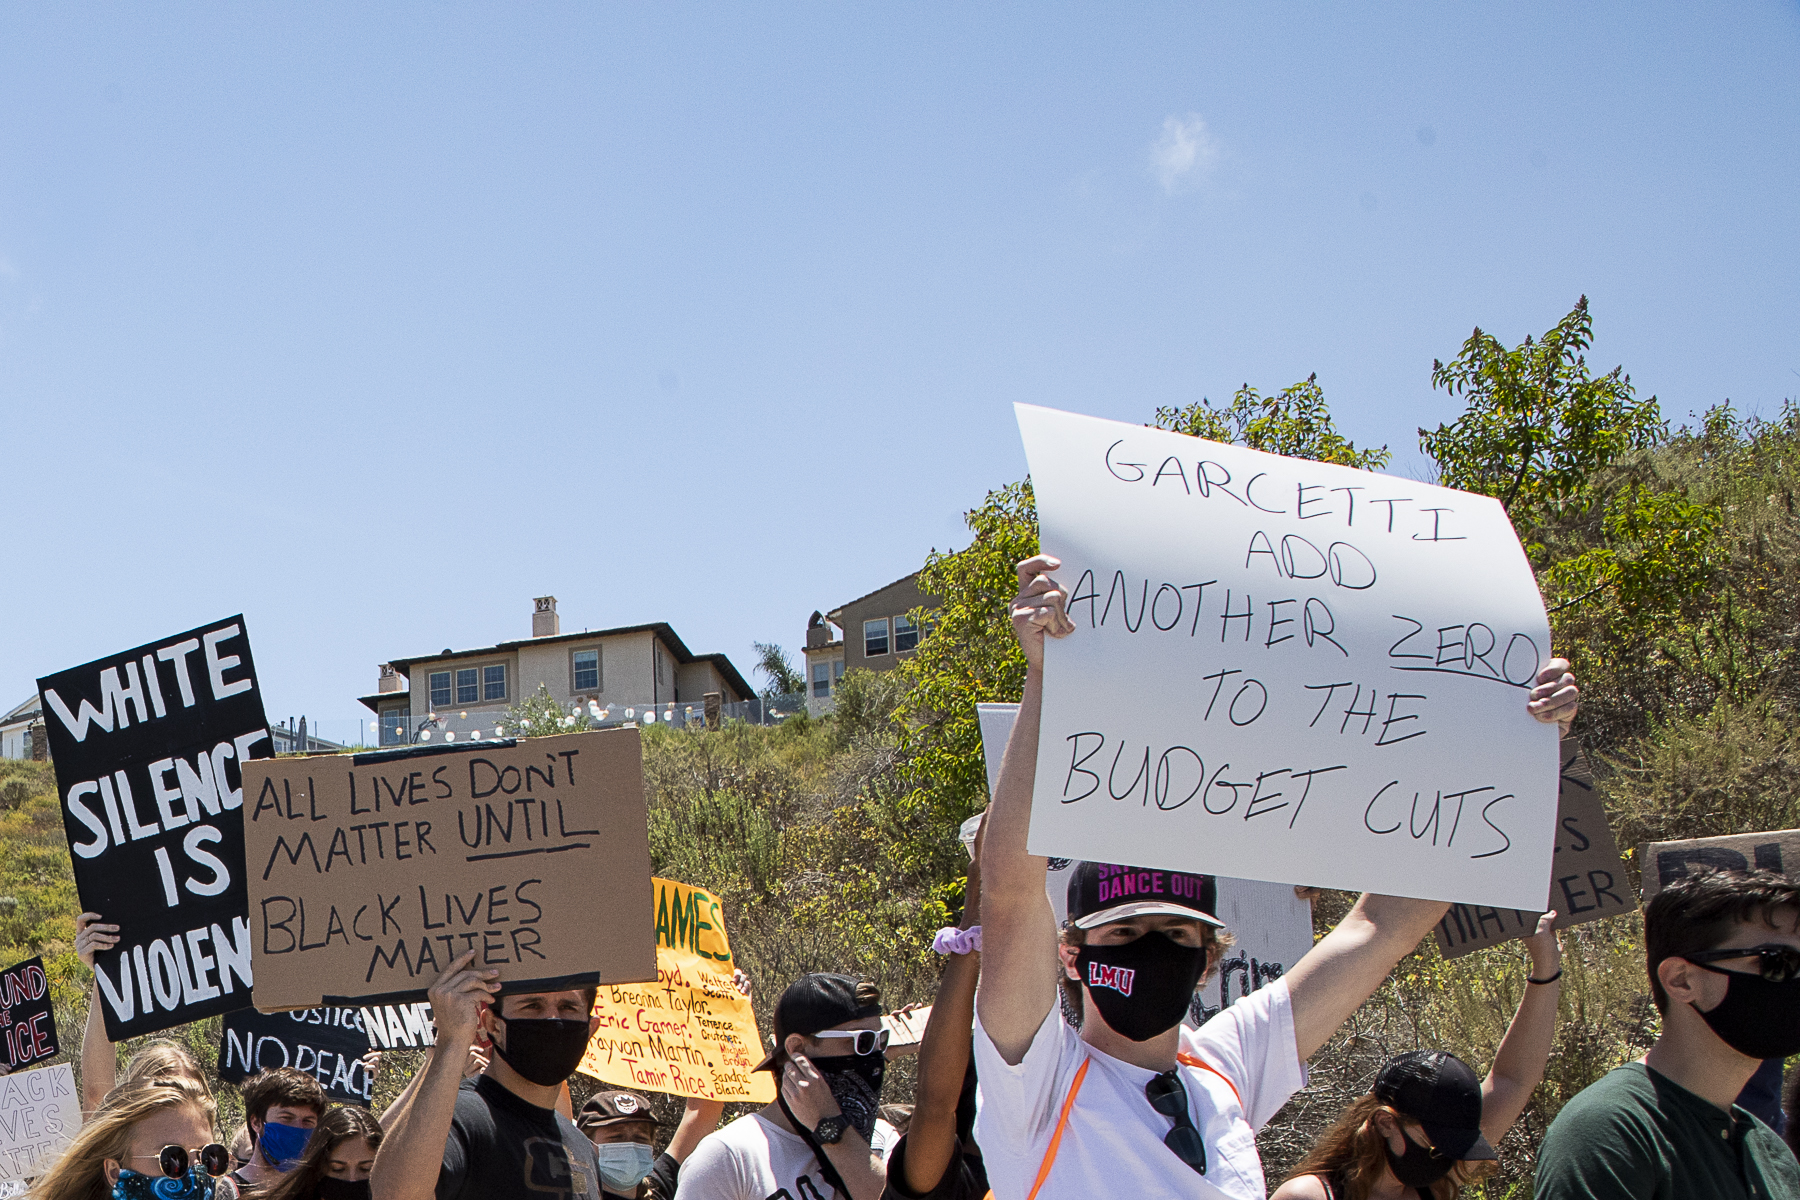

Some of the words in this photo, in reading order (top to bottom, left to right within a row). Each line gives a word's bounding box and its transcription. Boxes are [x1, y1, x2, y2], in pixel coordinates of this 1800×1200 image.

[1105, 440, 1467, 542] GARCETTI
[1246, 531, 1376, 590] ADD
[1066, 569, 1349, 657] ANOTHER
[1388, 614, 1540, 687] ZERO
[44, 623, 253, 743] WHITE
[1202, 669, 1268, 726] TO
[1304, 682, 1427, 746] THE
[252, 776, 328, 822] ALL
[350, 766, 452, 816] LIVES
[1061, 732, 1348, 829] BUDGET
[1364, 780, 1515, 859] CUTS
[153, 824, 231, 908] IS
[262, 820, 437, 881] MATTER
[457, 799, 601, 849] UNTIL
[260, 893, 402, 956] BLACK
[420, 879, 544, 931] LIVES
[1099, 872, 1164, 903] DANCE
[1170, 873, 1205, 900] OUT
[94, 914, 254, 1024] VIOLEN
[365, 928, 547, 984] MATTER
[1088, 960, 1136, 997] LMU
[593, 1005, 631, 1030] Eric
[611, 984, 663, 1010] Breonna
[226, 1027, 290, 1073] NO
[294, 1044, 374, 1100] PEACE
[620, 1057, 668, 1088] Tamir
